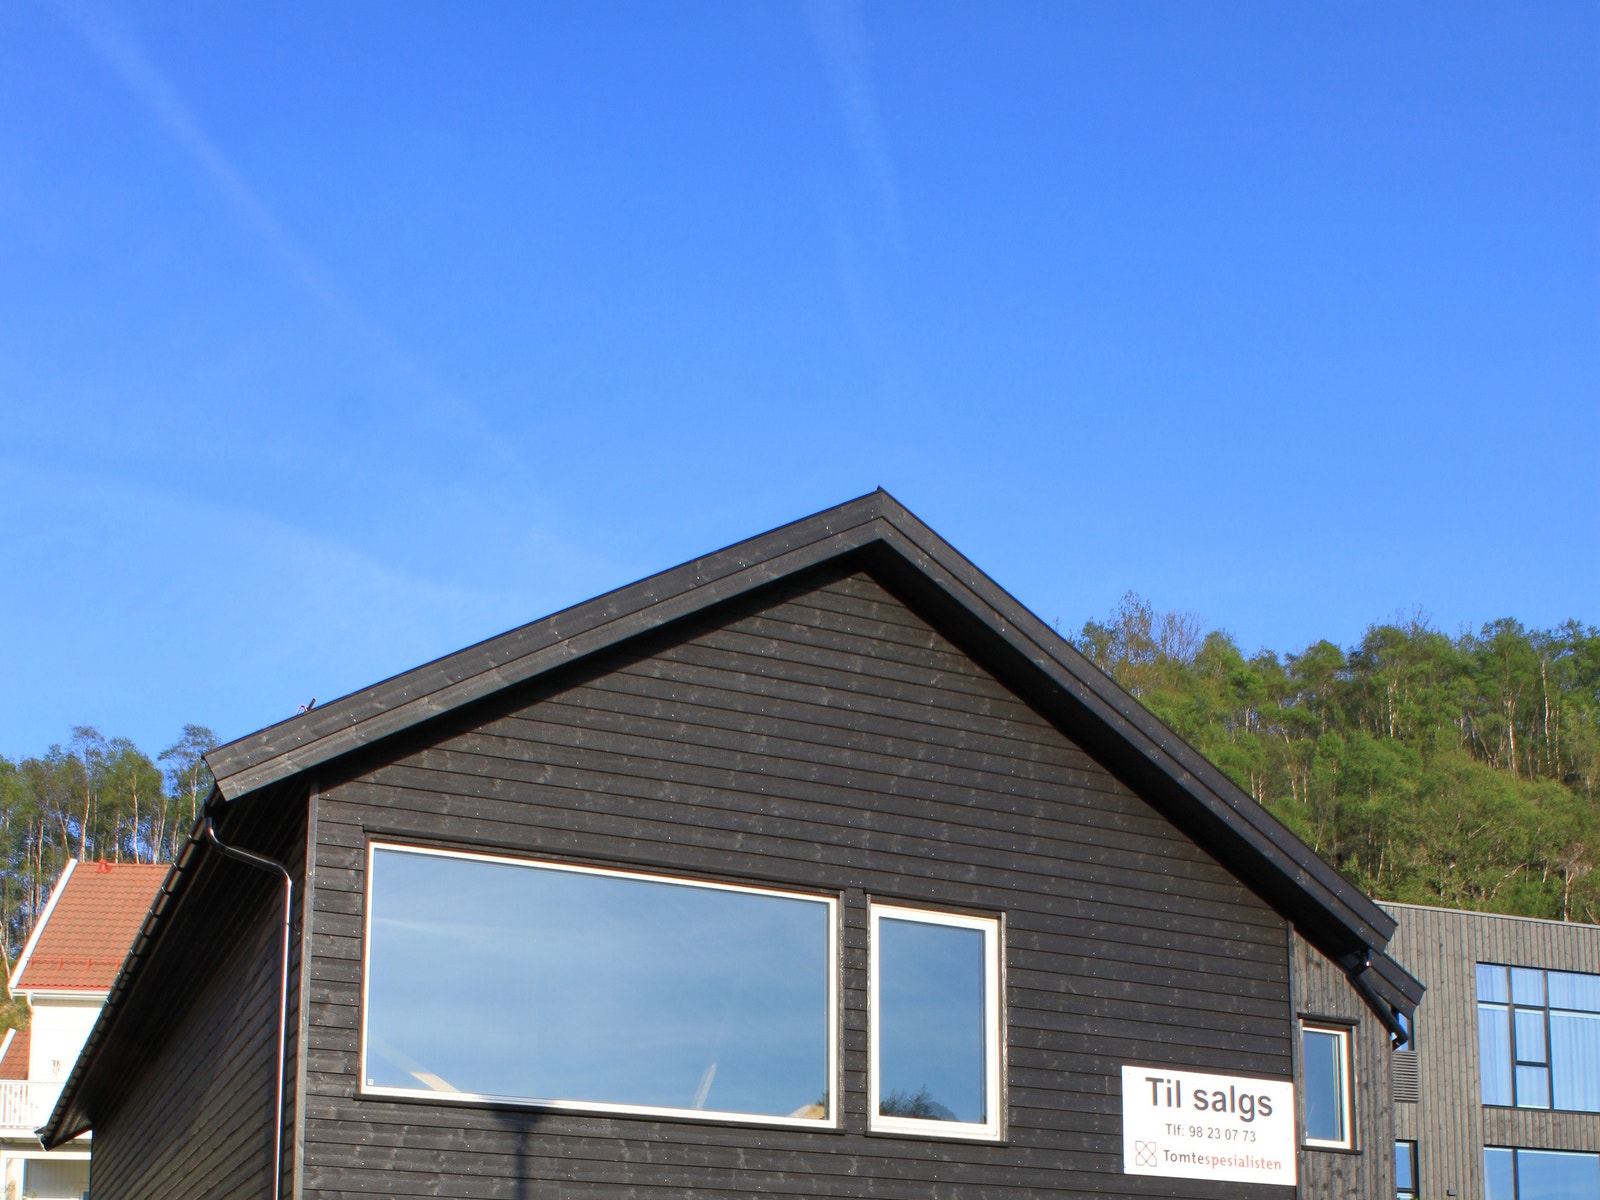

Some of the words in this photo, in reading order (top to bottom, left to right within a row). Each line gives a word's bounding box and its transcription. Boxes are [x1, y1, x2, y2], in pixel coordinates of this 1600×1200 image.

[1145, 1077, 1181, 1108] Til
[1193, 1085, 1273, 1123] salgs
[1165, 1123, 1185, 1137] Tlf:
[1189, 1125, 1203, 1138] 98
[1207, 1127, 1221, 1140] 23
[1224, 1129, 1238, 1141] 07
[1242, 1130, 1256, 1143] 73
[1163, 1149, 1282, 1170] Tomtespesialisten
